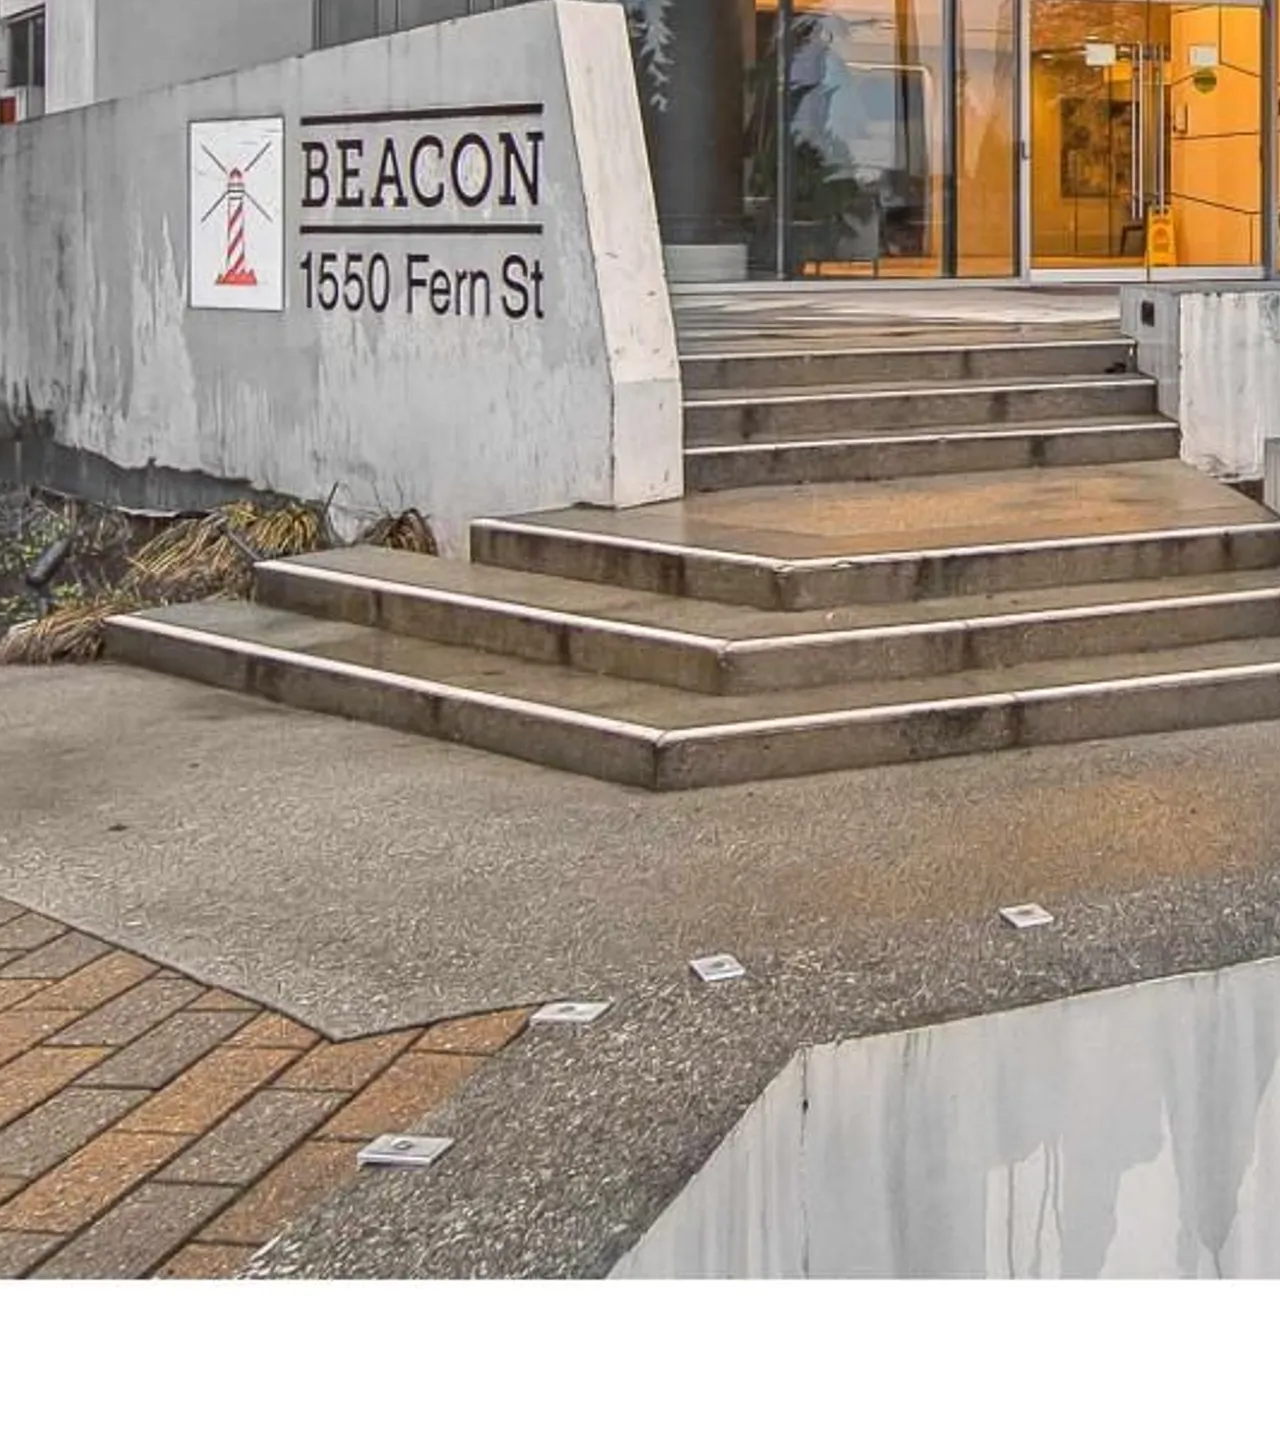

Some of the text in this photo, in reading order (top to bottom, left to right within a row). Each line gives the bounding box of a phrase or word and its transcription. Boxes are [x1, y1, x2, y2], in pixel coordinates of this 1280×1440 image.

[300, 131, 544, 208] BEACON
[299, 250, 545, 320] 1550 Fern St
